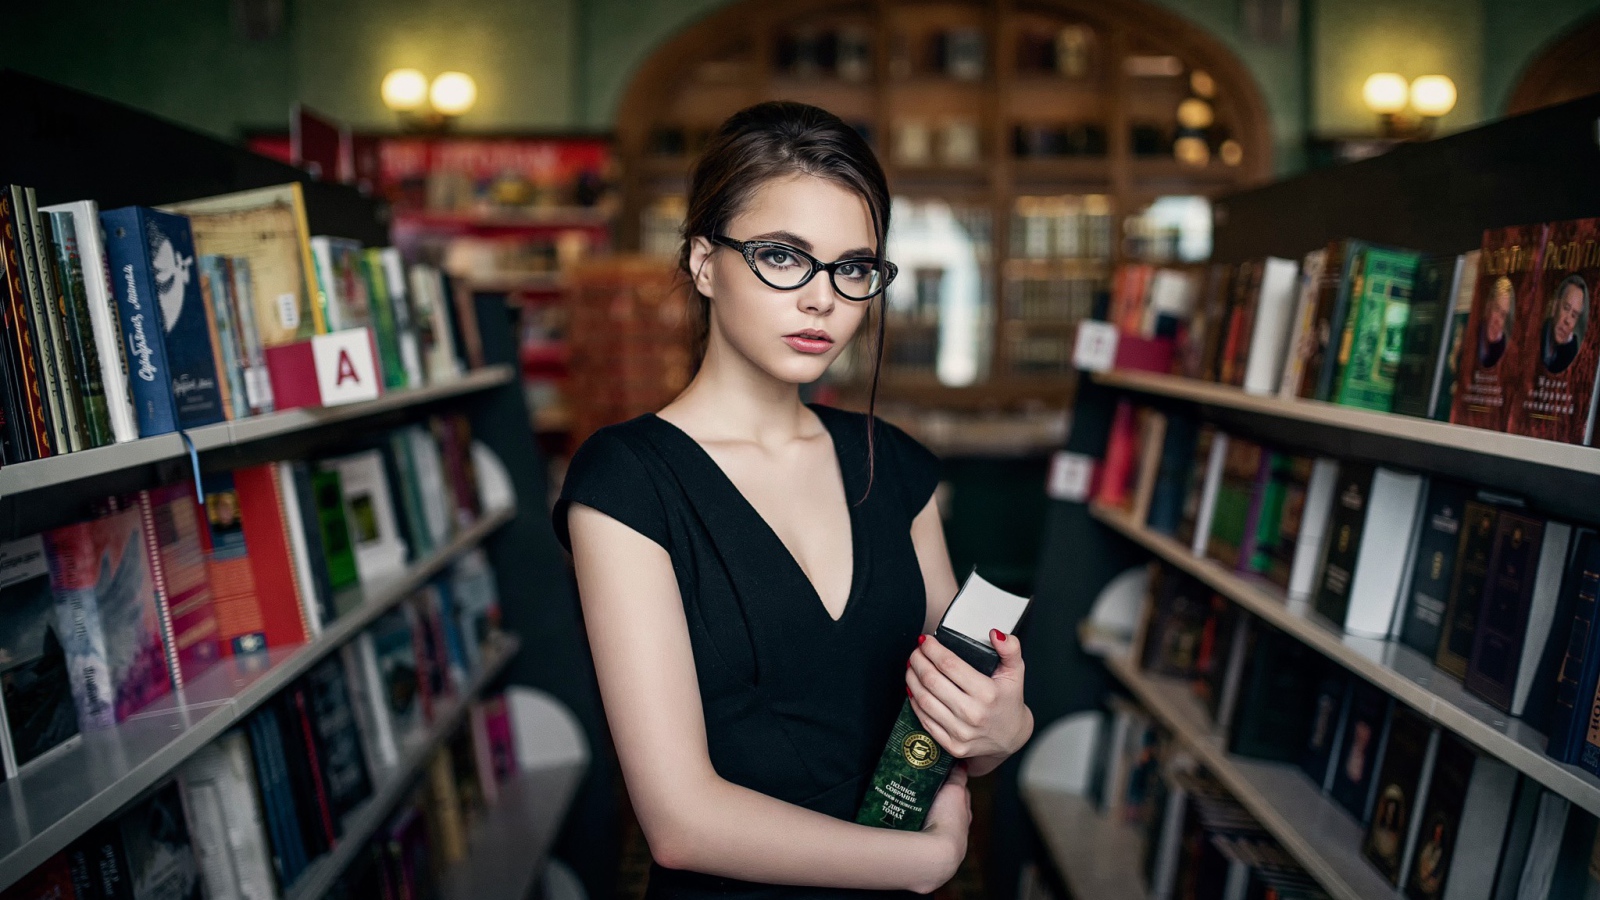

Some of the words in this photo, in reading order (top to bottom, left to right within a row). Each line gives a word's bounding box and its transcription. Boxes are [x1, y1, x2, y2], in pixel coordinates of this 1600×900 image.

[336, 349, 361, 386] А
[874, 785, 895, 801] РОМАНОВ
[885, 784, 917, 803] СОБРАНИЕ
[890, 780, 917, 797] ПОЛНОЕ
[882, 805, 904, 820] ТОМАХ
[887, 803, 906, 815] ДВУХ
